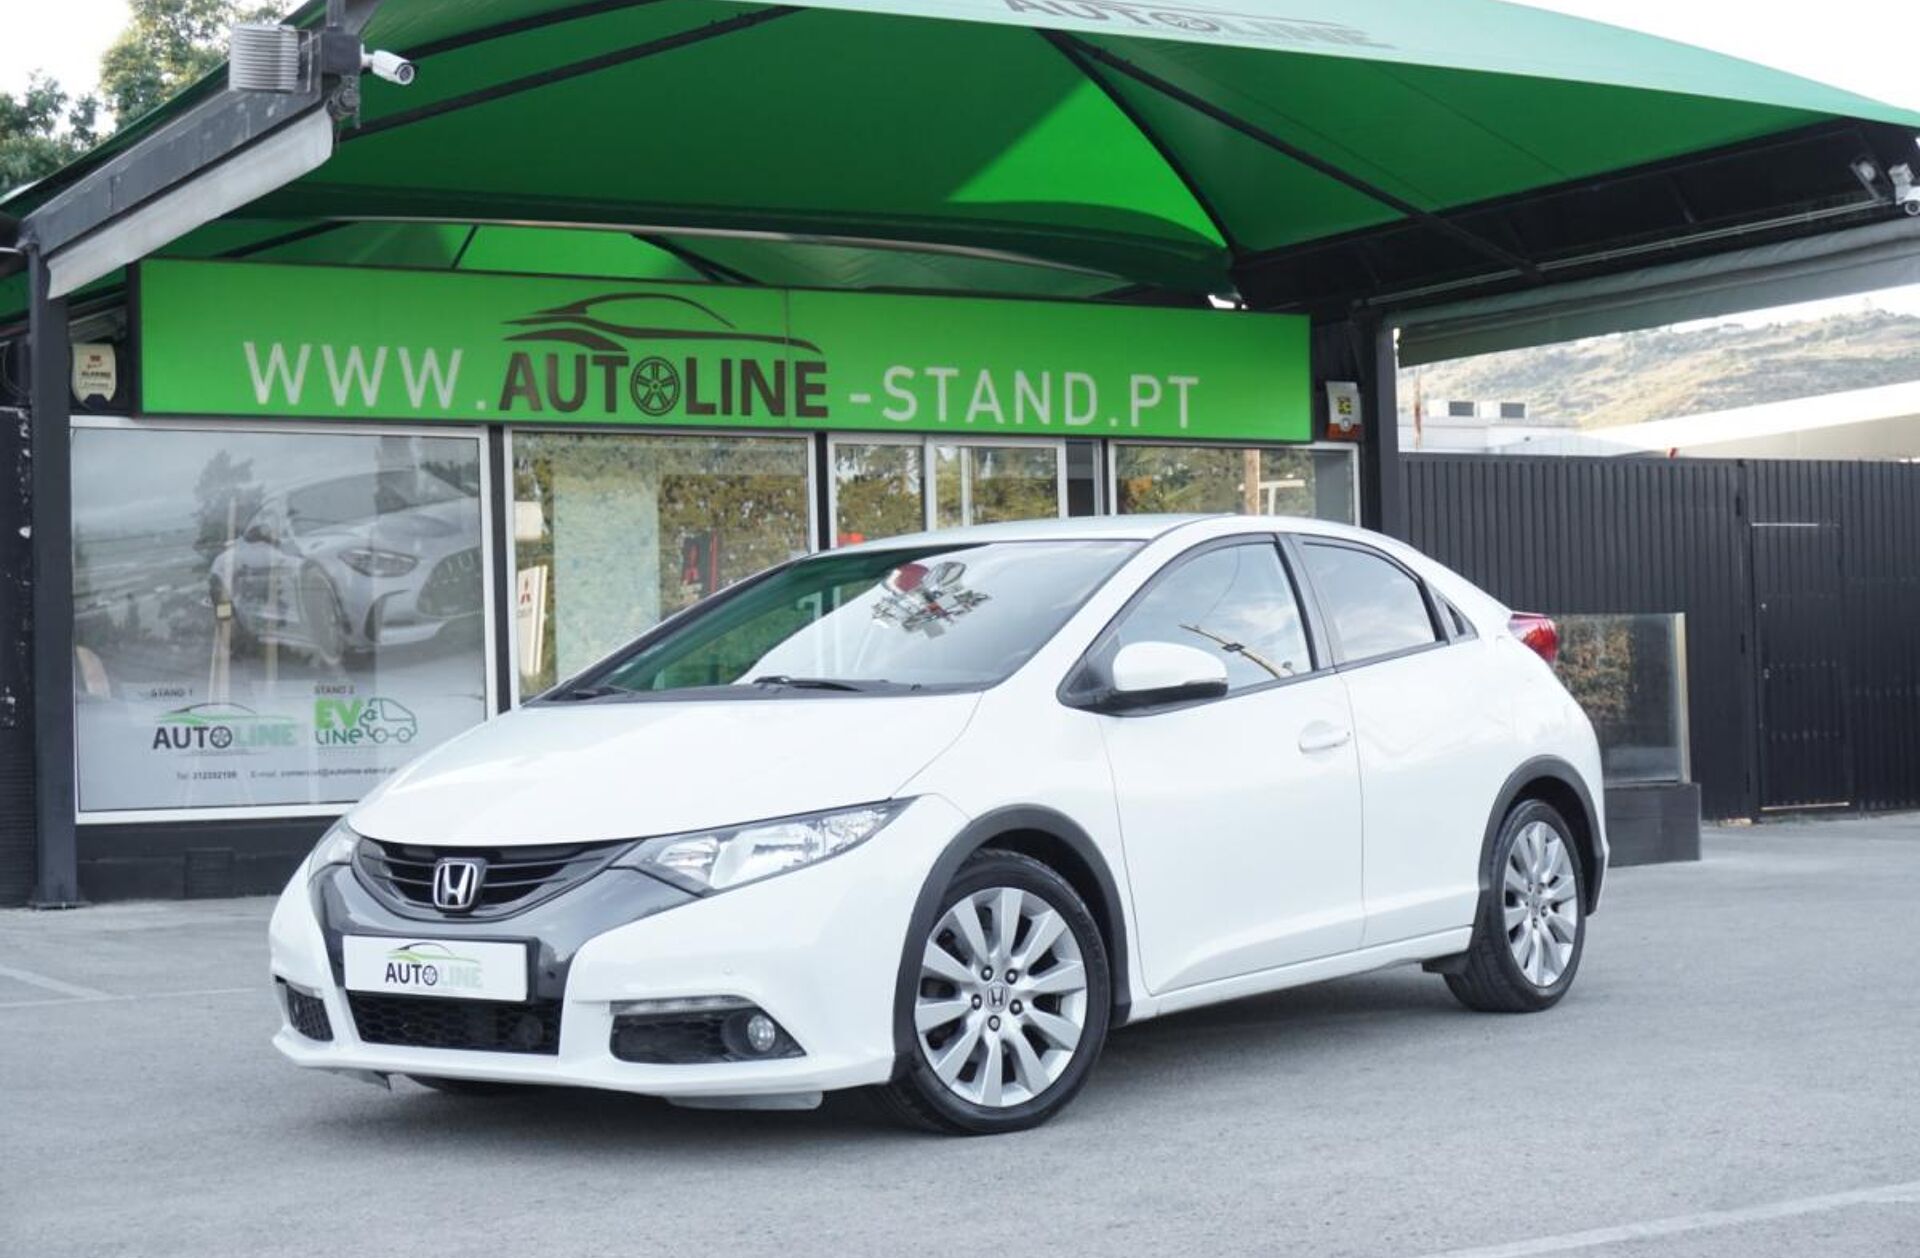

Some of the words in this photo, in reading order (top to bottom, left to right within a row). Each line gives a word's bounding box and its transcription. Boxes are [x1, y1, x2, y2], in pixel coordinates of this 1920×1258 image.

[314, 697, 362, 730] EV
[152, 725, 298, 749] AUTOLINE
[385, 962, 483, 988] AUTOLINE
